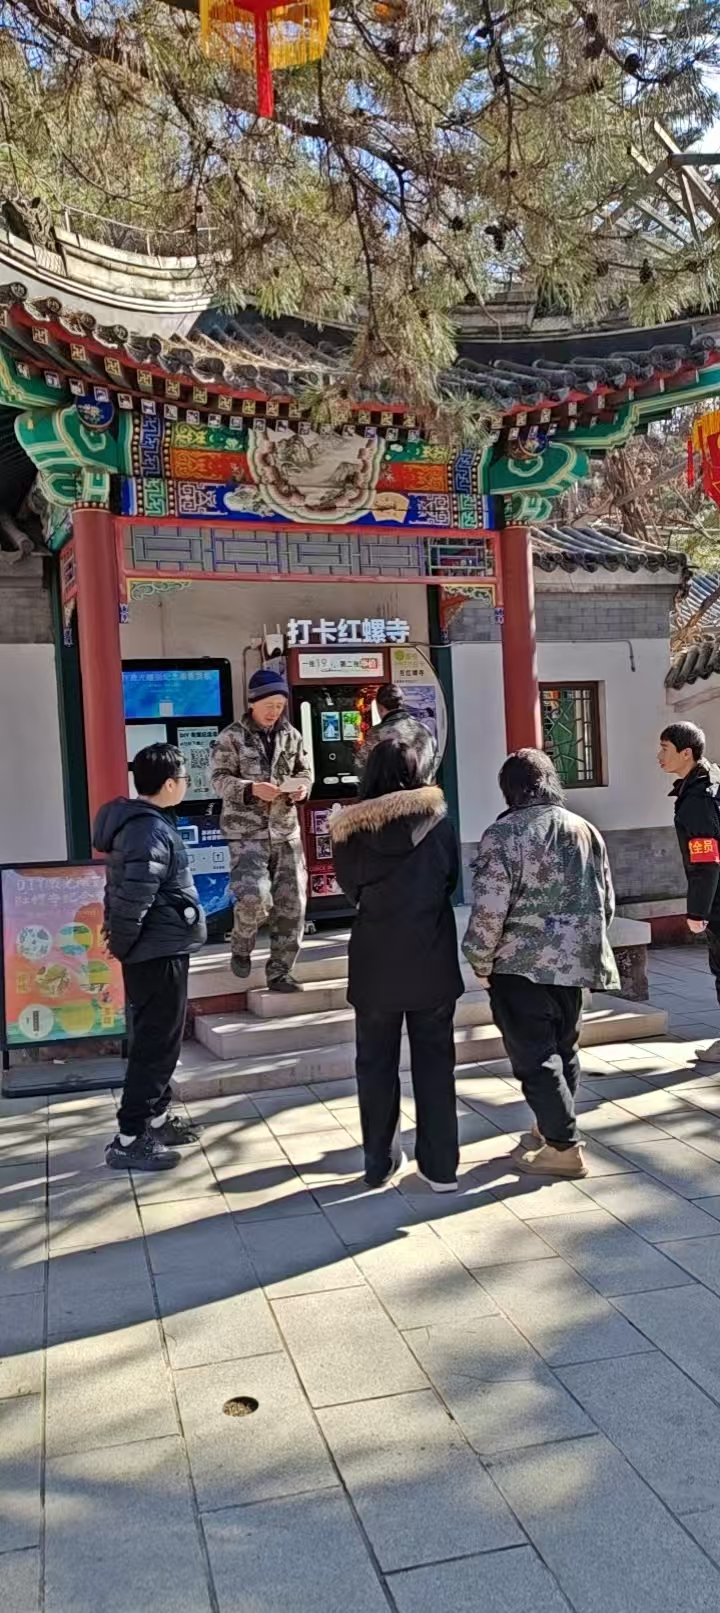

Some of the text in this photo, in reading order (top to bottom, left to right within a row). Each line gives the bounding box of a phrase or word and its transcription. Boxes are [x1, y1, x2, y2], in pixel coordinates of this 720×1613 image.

[287, 618, 410, 644] 打卡红螺寺
